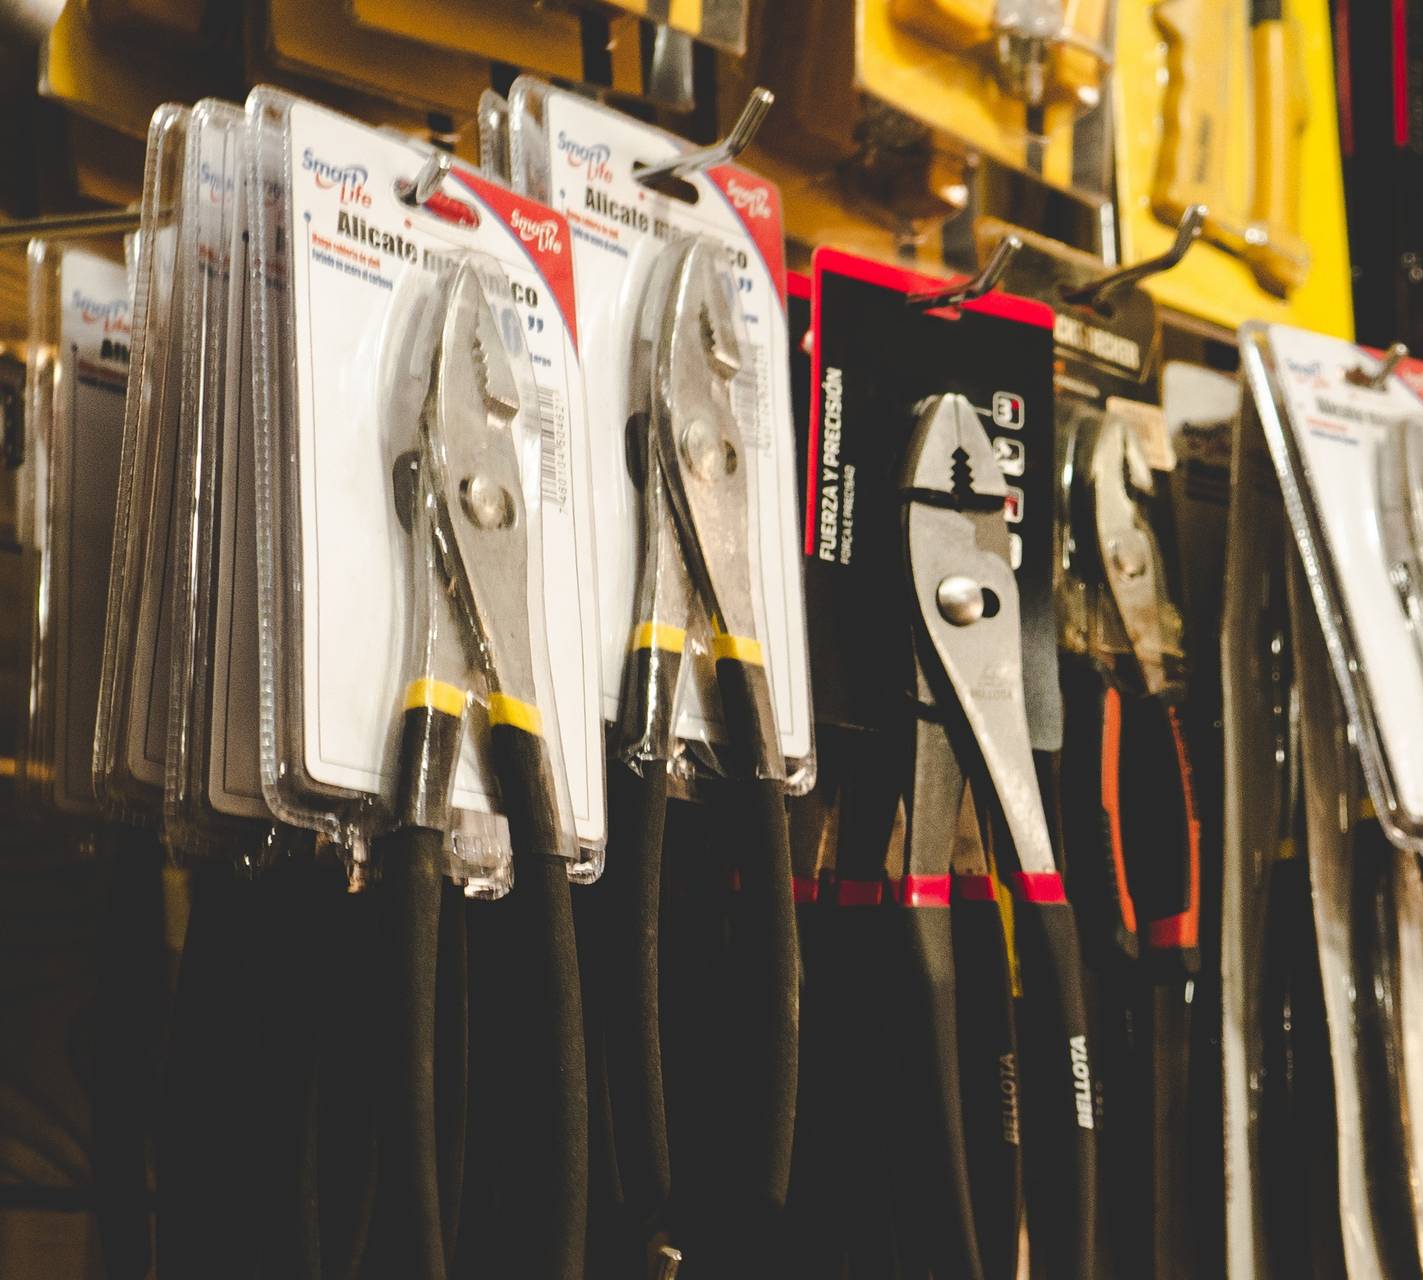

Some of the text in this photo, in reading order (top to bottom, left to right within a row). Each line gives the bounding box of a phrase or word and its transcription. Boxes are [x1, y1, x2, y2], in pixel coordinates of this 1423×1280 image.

[302, 146, 369, 186] Smart
[340, 181, 372, 208] Life
[585, 186, 649, 234] Alicate
[336, 209, 418, 265] Alicate
[510, 208, 559, 241] Smart
[819, 366, 843, 562] FUERZA Y PRECISIÓN
[999, 1053, 1020, 1145] BELLOTA
[1069, 1035, 1094, 1130] BELLOTA
